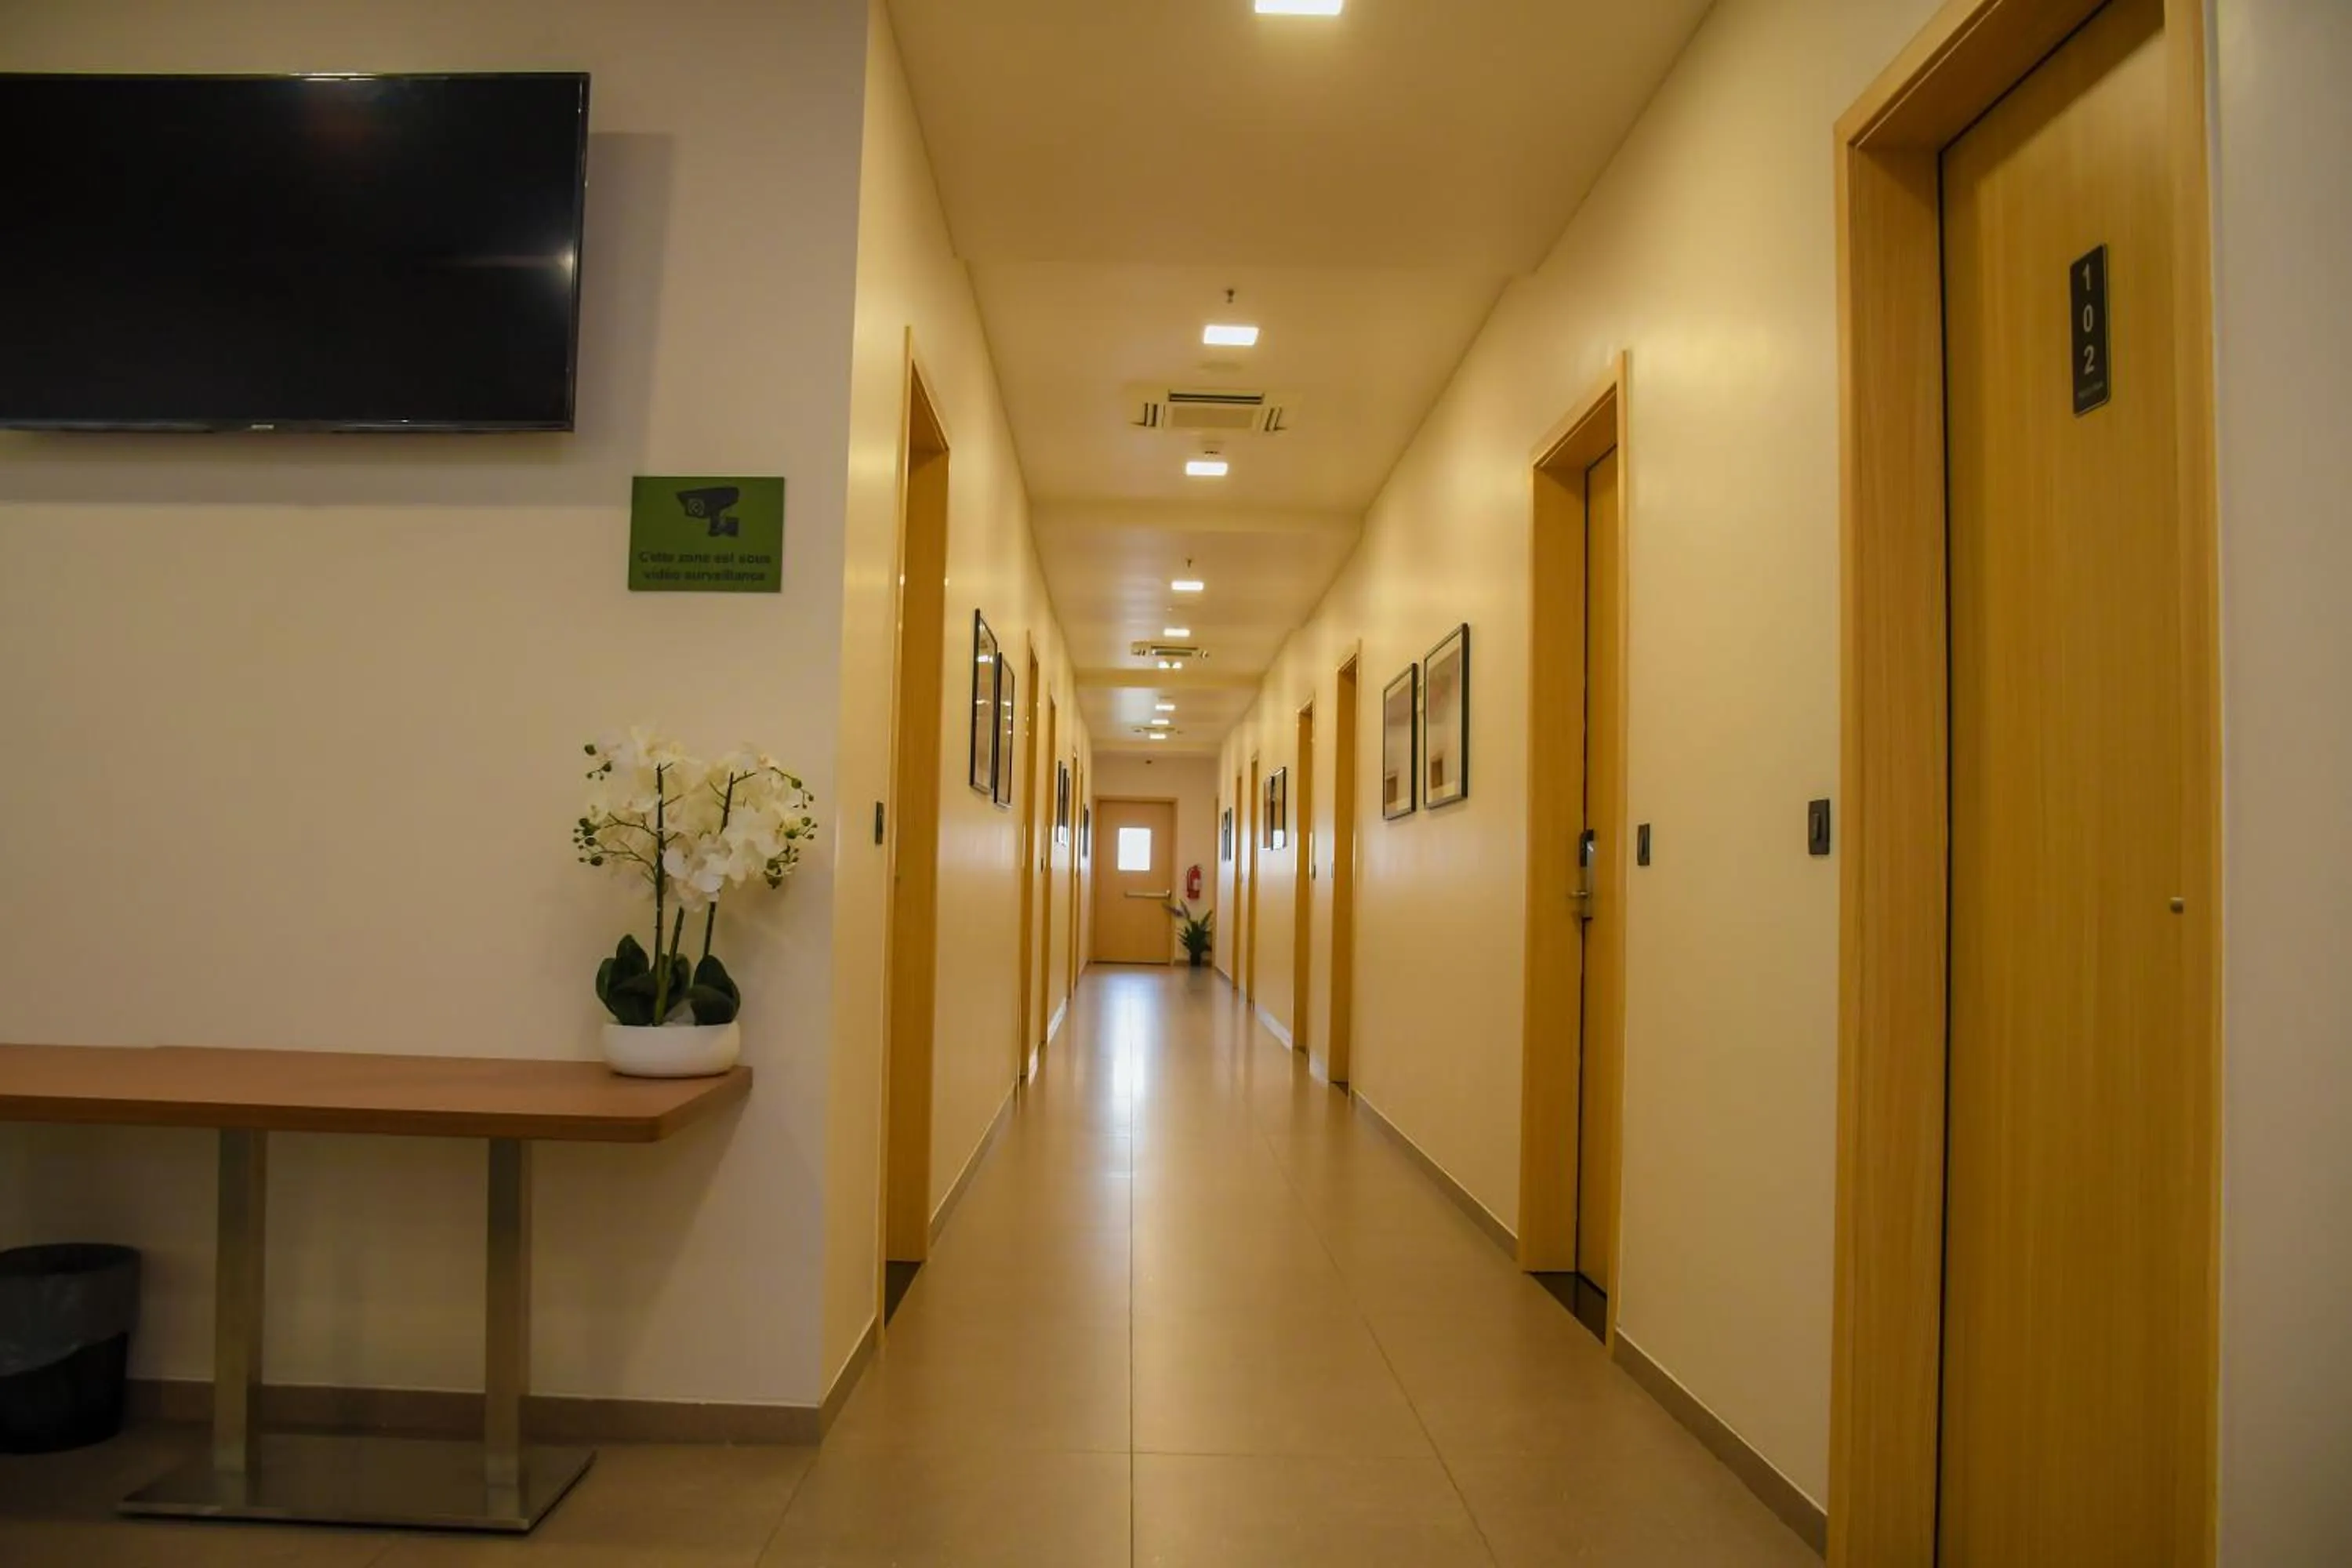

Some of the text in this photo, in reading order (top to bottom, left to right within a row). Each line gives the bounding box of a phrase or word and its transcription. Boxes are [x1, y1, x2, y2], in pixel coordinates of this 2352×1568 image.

[2082, 263, 2095, 375] 102
[638, 551, 771, 564] Cette zone est sous
[684, 569, 766, 582] surveillance
